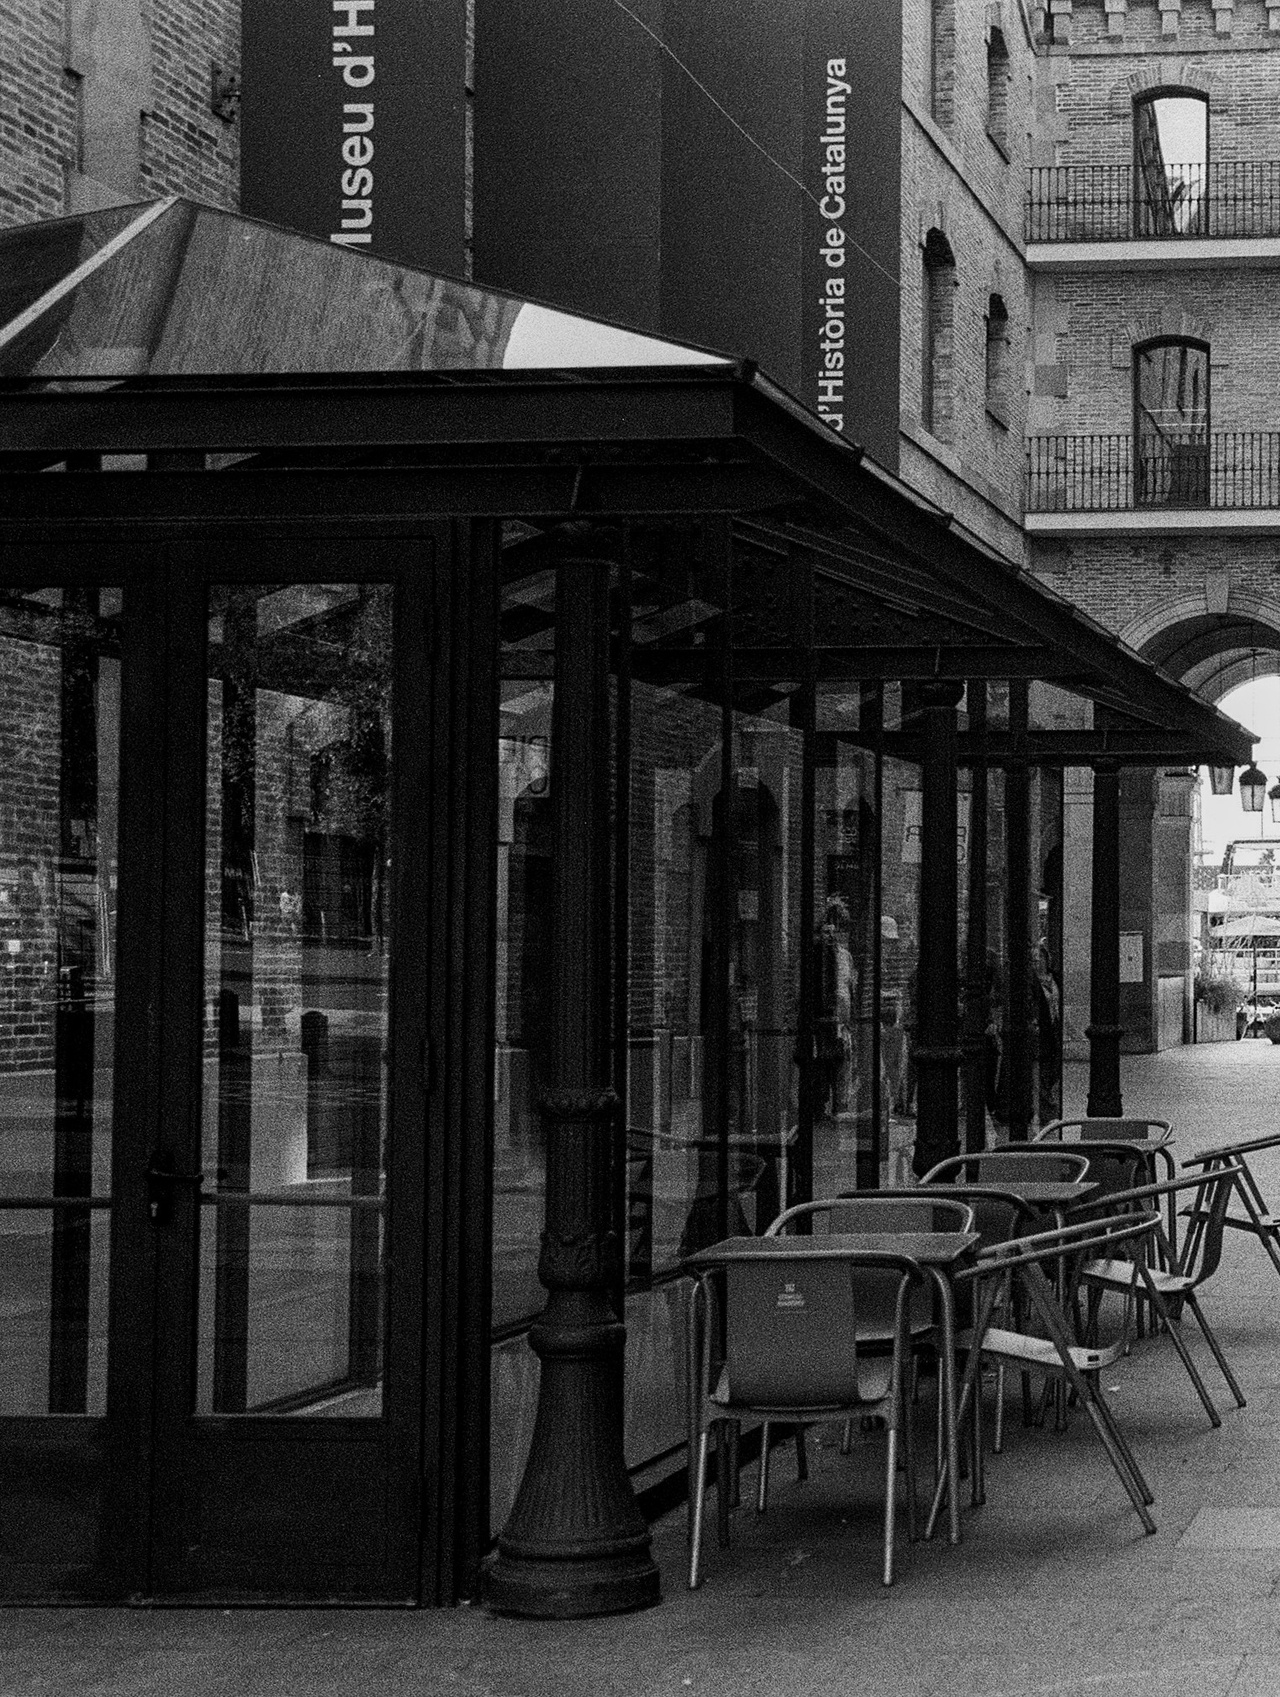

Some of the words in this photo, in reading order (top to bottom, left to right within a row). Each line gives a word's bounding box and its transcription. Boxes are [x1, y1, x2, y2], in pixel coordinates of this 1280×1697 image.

[330, 103, 374, 245] useu
[819, 58, 852, 219] Catalunya
[819, 228, 846, 268] de
[818, 278, 845, 432] d'Història
